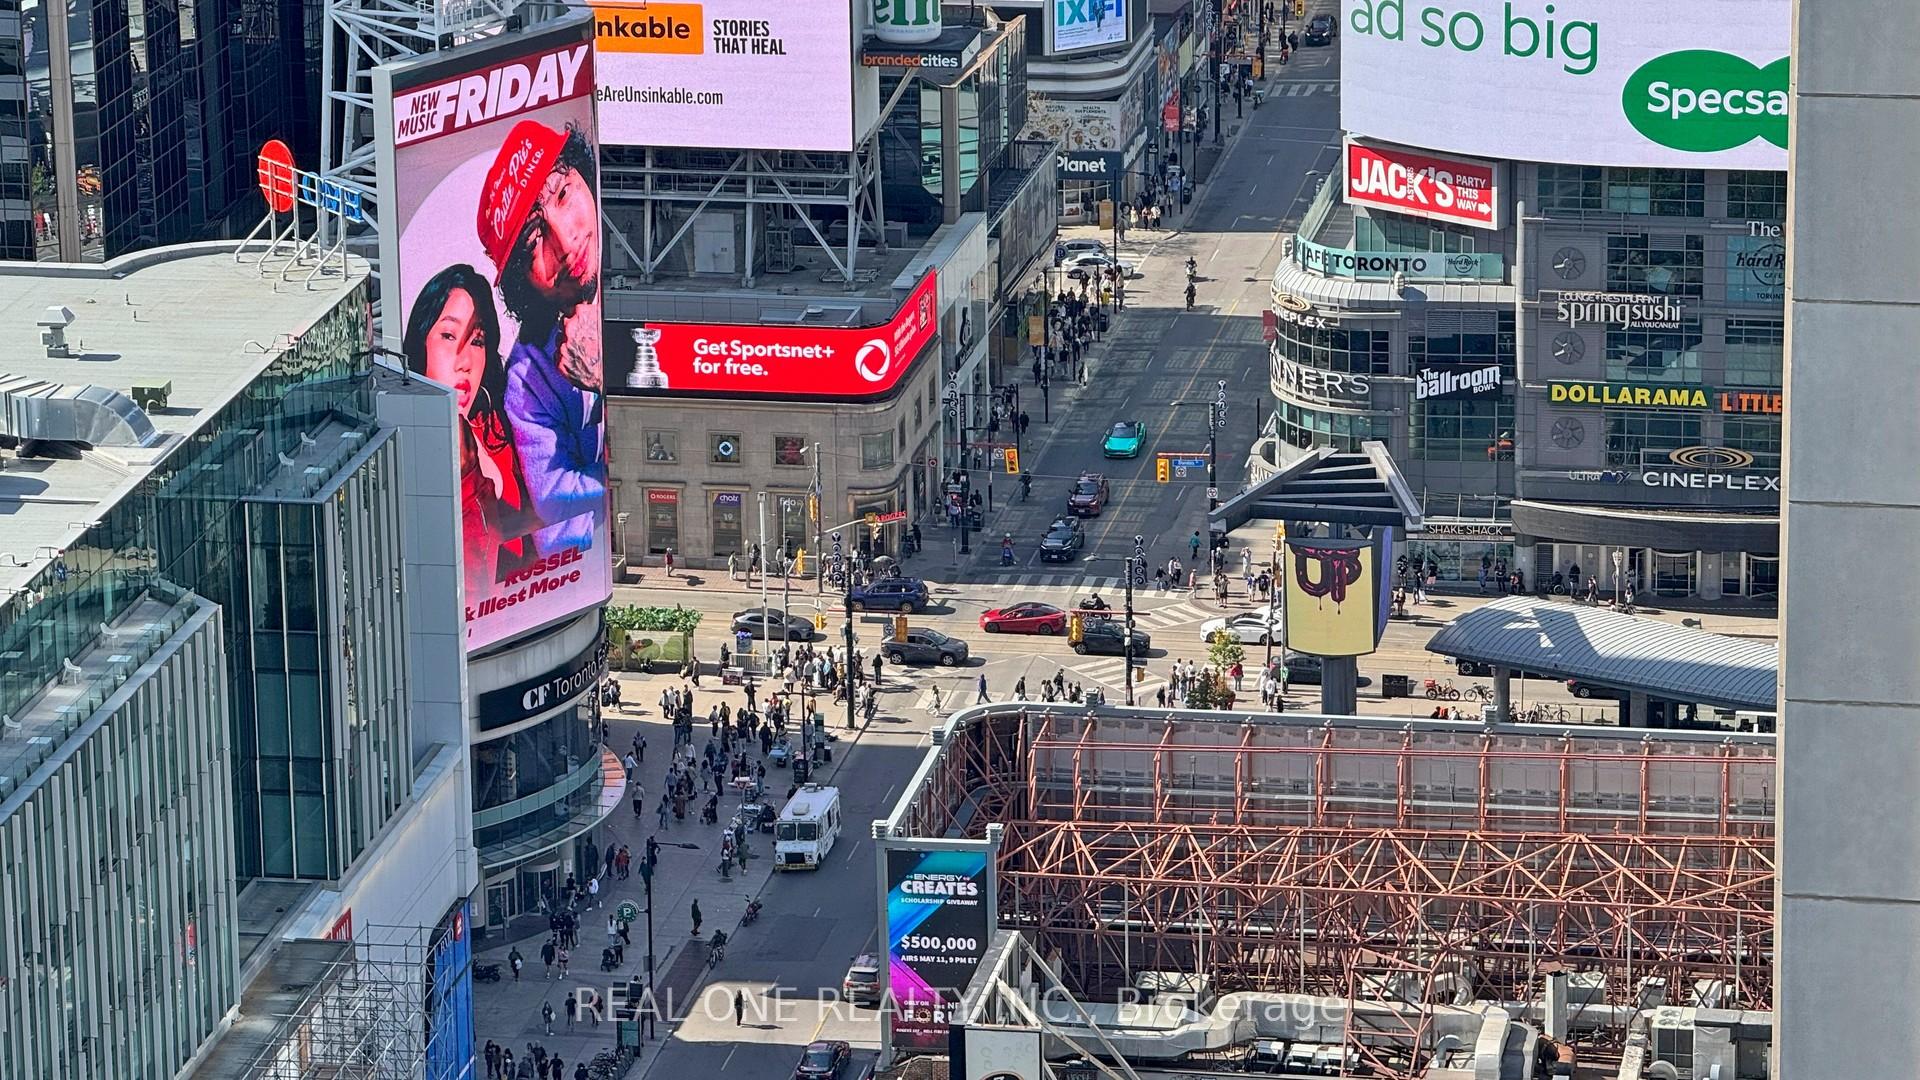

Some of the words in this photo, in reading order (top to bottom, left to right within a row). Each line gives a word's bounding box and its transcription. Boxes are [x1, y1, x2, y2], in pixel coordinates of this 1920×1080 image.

[597, 16, 690, 39] nkable
[713, 20, 769, 37] STORIES
[714, 38, 747, 54] THAT
[751, 39, 786, 55] HEAL
[1421, 7, 1485, 51] so
[1504, 2, 1598, 75] big
[441, 44, 589, 132] FRIDAY
[596, 85, 723, 104] eAreUnsinkable.com
[411, 90, 441, 116] NEW
[397, 111, 438, 138] MUSIC
[1057, 155, 1106, 172] Planet
[1352, 157, 1454, 208] JACK'S
[1456, 174, 1486, 188] PARTY
[1456, 186, 1479, 199] THIS
[1456, 198, 1477, 211] WAY
[1747, 221, 1780, 237] The
[1333, 252, 1427, 272] TORONTO
[1272, 303, 1326, 329] CINEPLEX
[693, 338, 727, 355] Get
[730, 340, 834, 360] Sportsnet+
[693, 357, 720, 374] for
[725, 358, 768, 376] free.
[1420, 368, 1439, 381] The
[1473, 384, 1496, 394] BOWL
[1551, 384, 1707, 407] DOLLARAMA
[1721, 392, 1782, 413] LITTLE
[1643, 472, 1780, 491] CINEPLEX
[1429, 525, 1464, 535] SHAKE
[1466, 525, 1503, 535] SHACK
[478, 587, 527, 619] Illest
[529, 568, 581, 600] More
[523, 682, 550, 711] CF
[553, 660, 597, 698] Toronto
[914, 873, 963, 881] ENERGY
[901, 880, 978, 896] CREATES
[901, 897, 945, 905] SCHOLARSHIP
[901, 934, 977, 953] $500,000
[920, 955, 935, 963] MAY
